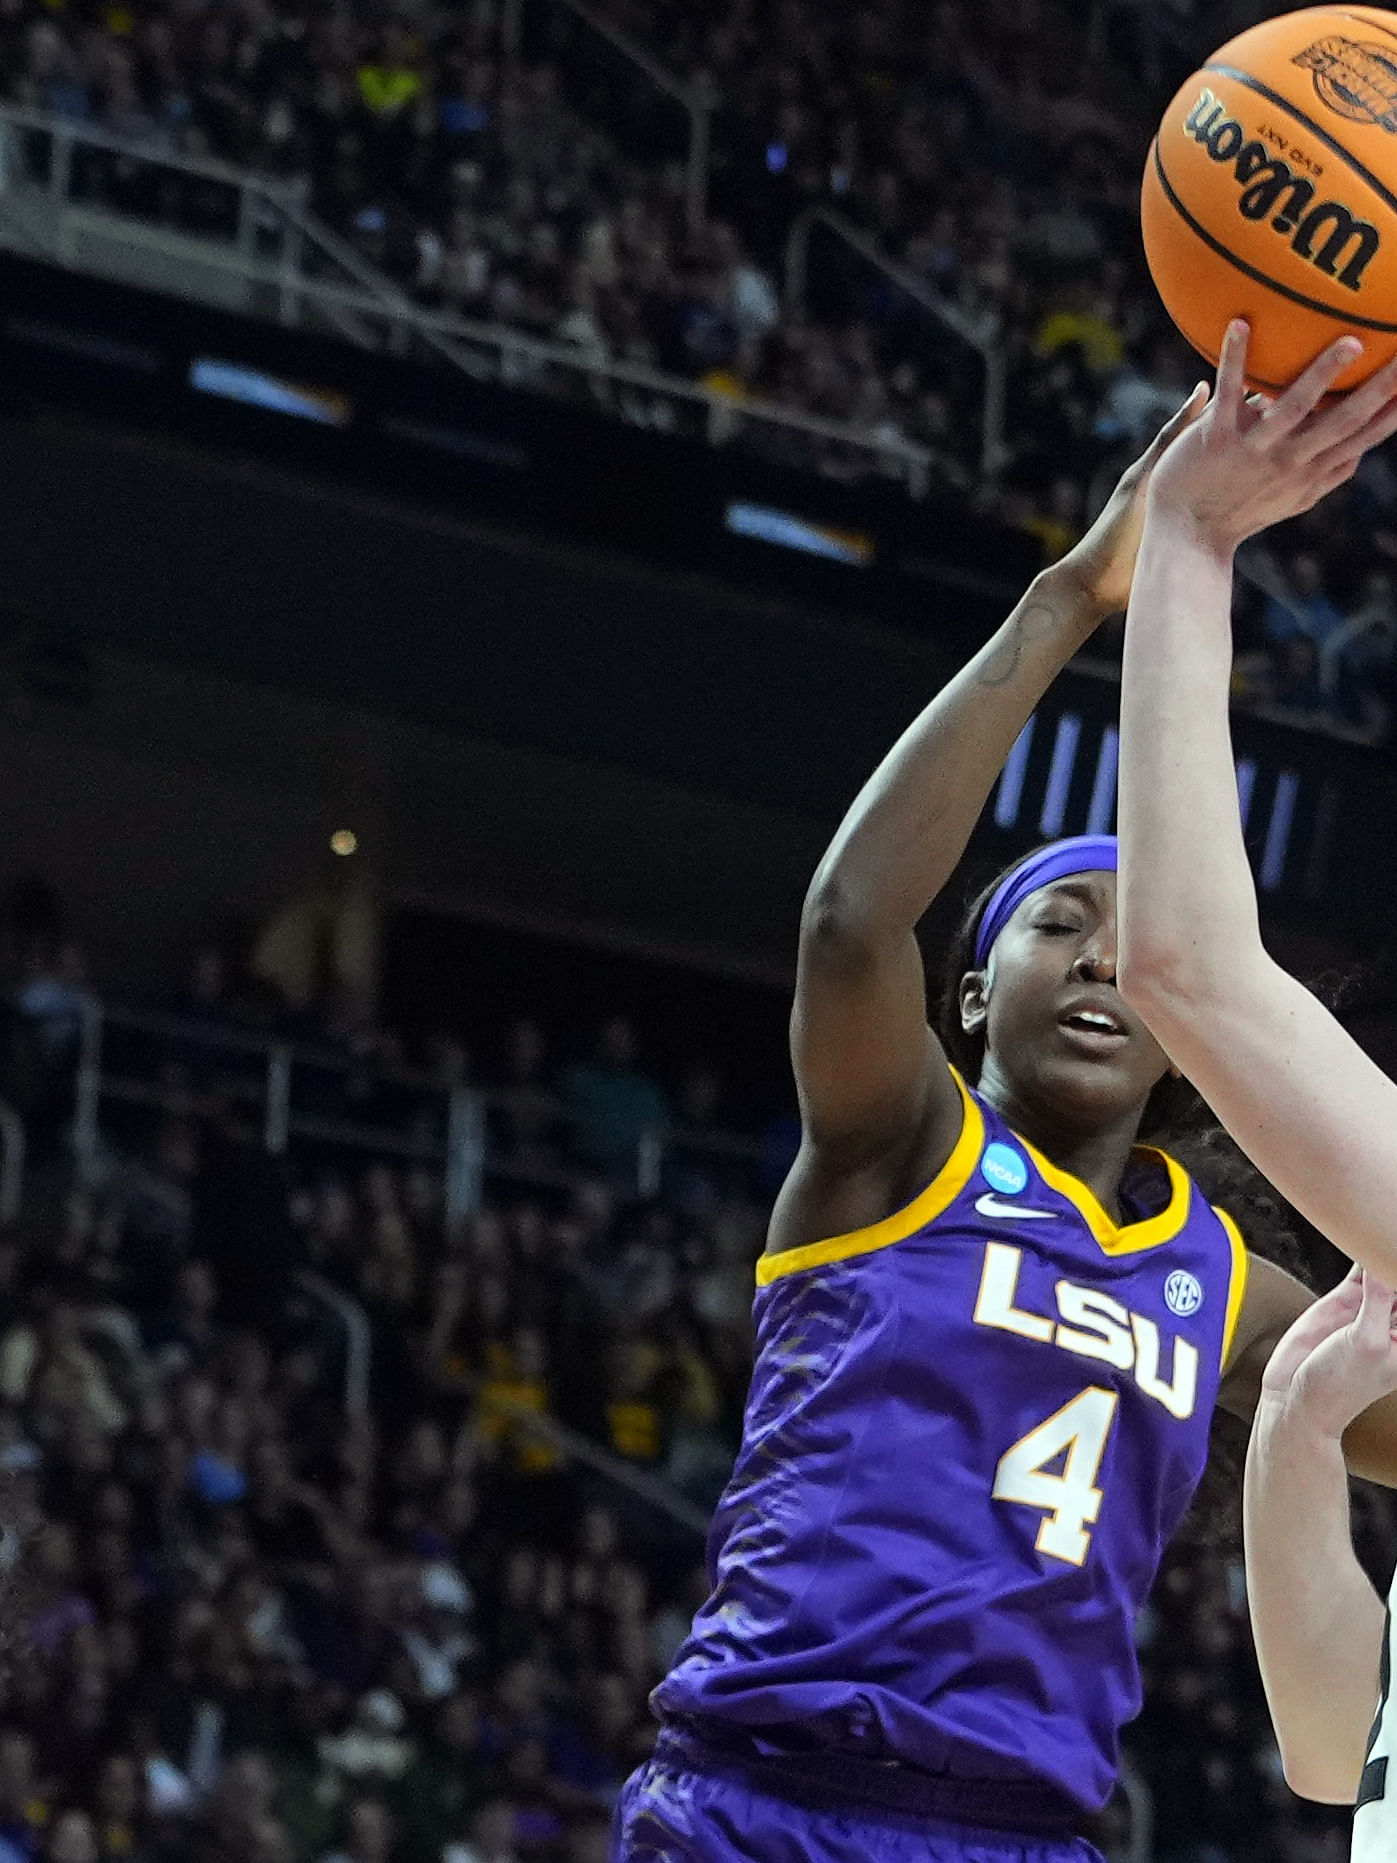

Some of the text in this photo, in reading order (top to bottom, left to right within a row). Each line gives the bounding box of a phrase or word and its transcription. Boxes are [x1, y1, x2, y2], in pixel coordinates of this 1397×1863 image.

[1184, 88, 1379, 292] Wilson
[984, 1158, 1021, 1189] NCAA
[973, 1242, 1197, 1420] LSU
[1168, 1274, 1199, 1312] SEC
[992, 1386, 1118, 1567] 4
